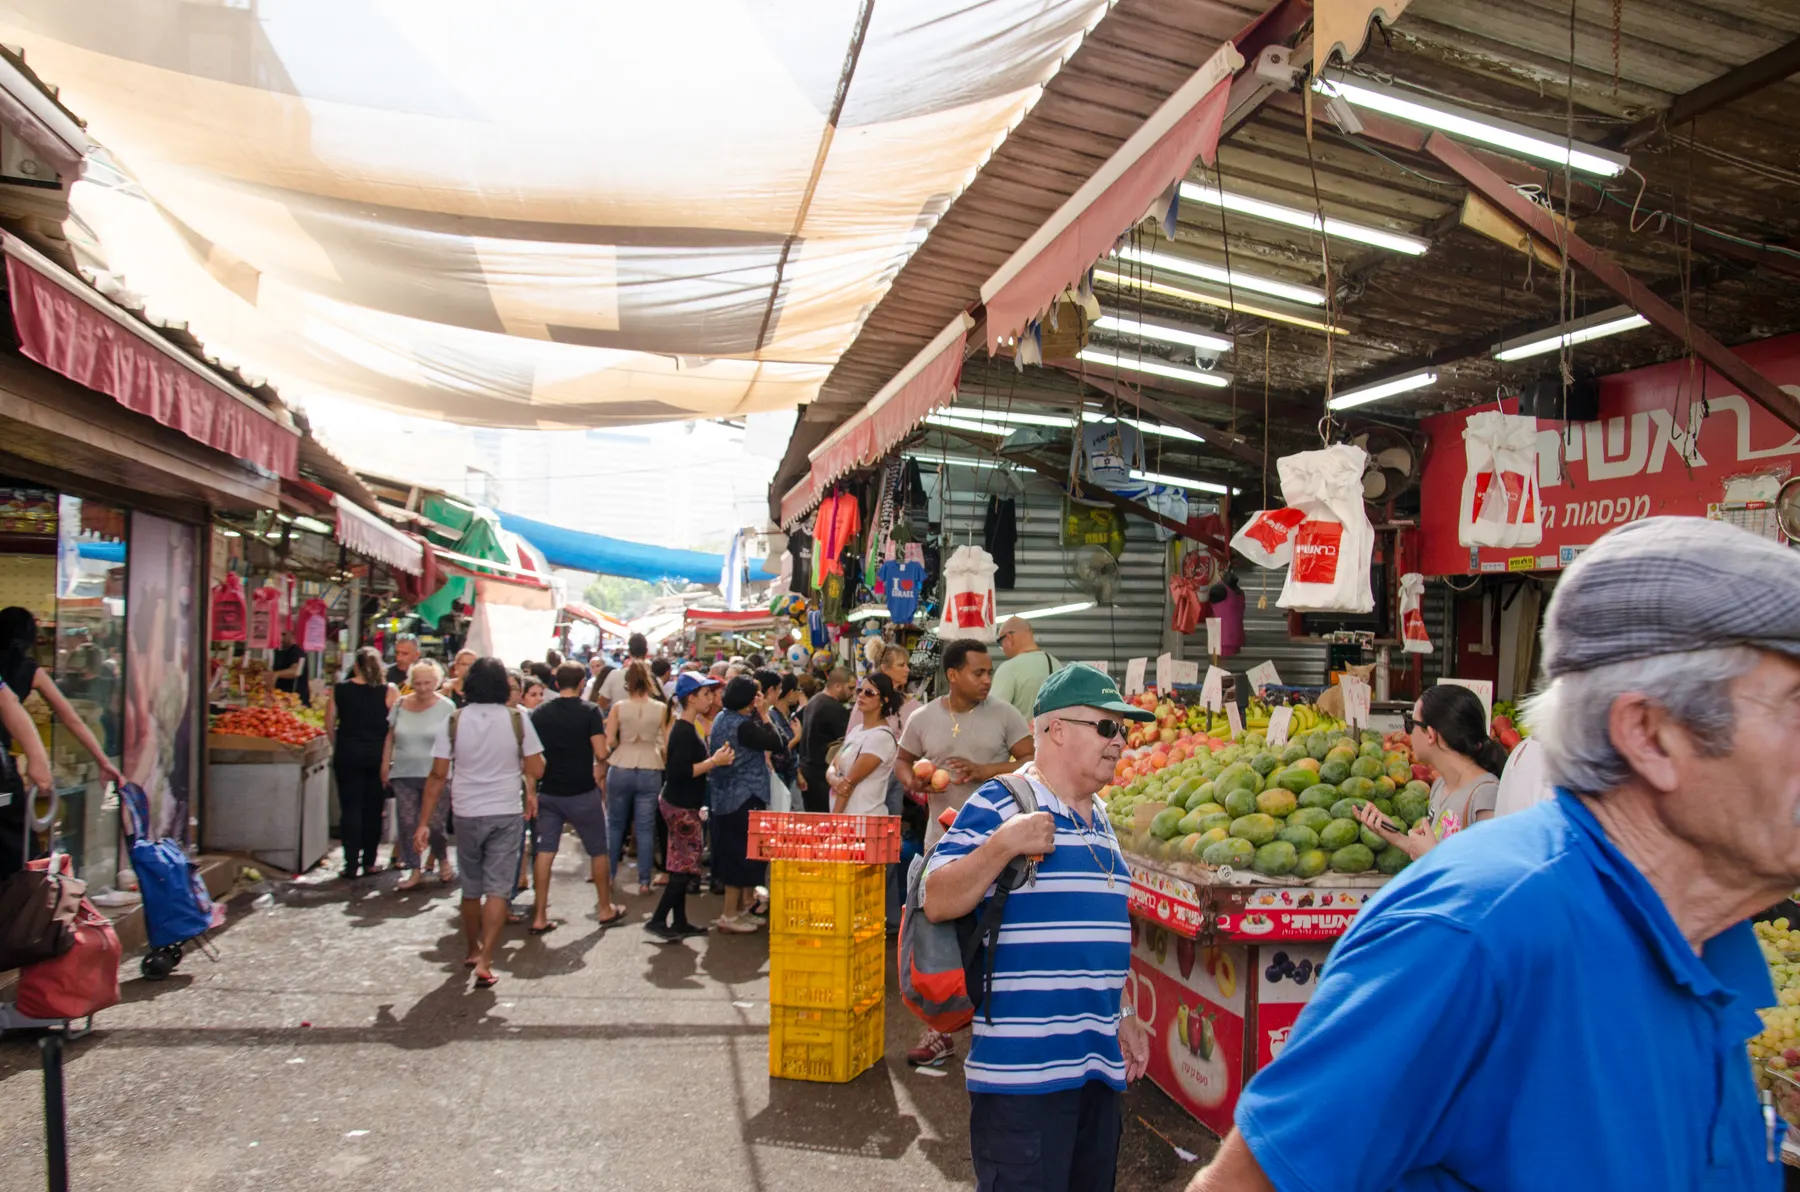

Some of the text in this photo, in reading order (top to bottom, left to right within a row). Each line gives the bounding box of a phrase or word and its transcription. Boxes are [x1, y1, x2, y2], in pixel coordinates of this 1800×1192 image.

[1562, 494, 1651, 528] מפסגות
[892, 577, 900, 591] I
[891, 590, 914, 598] ISRAEL
